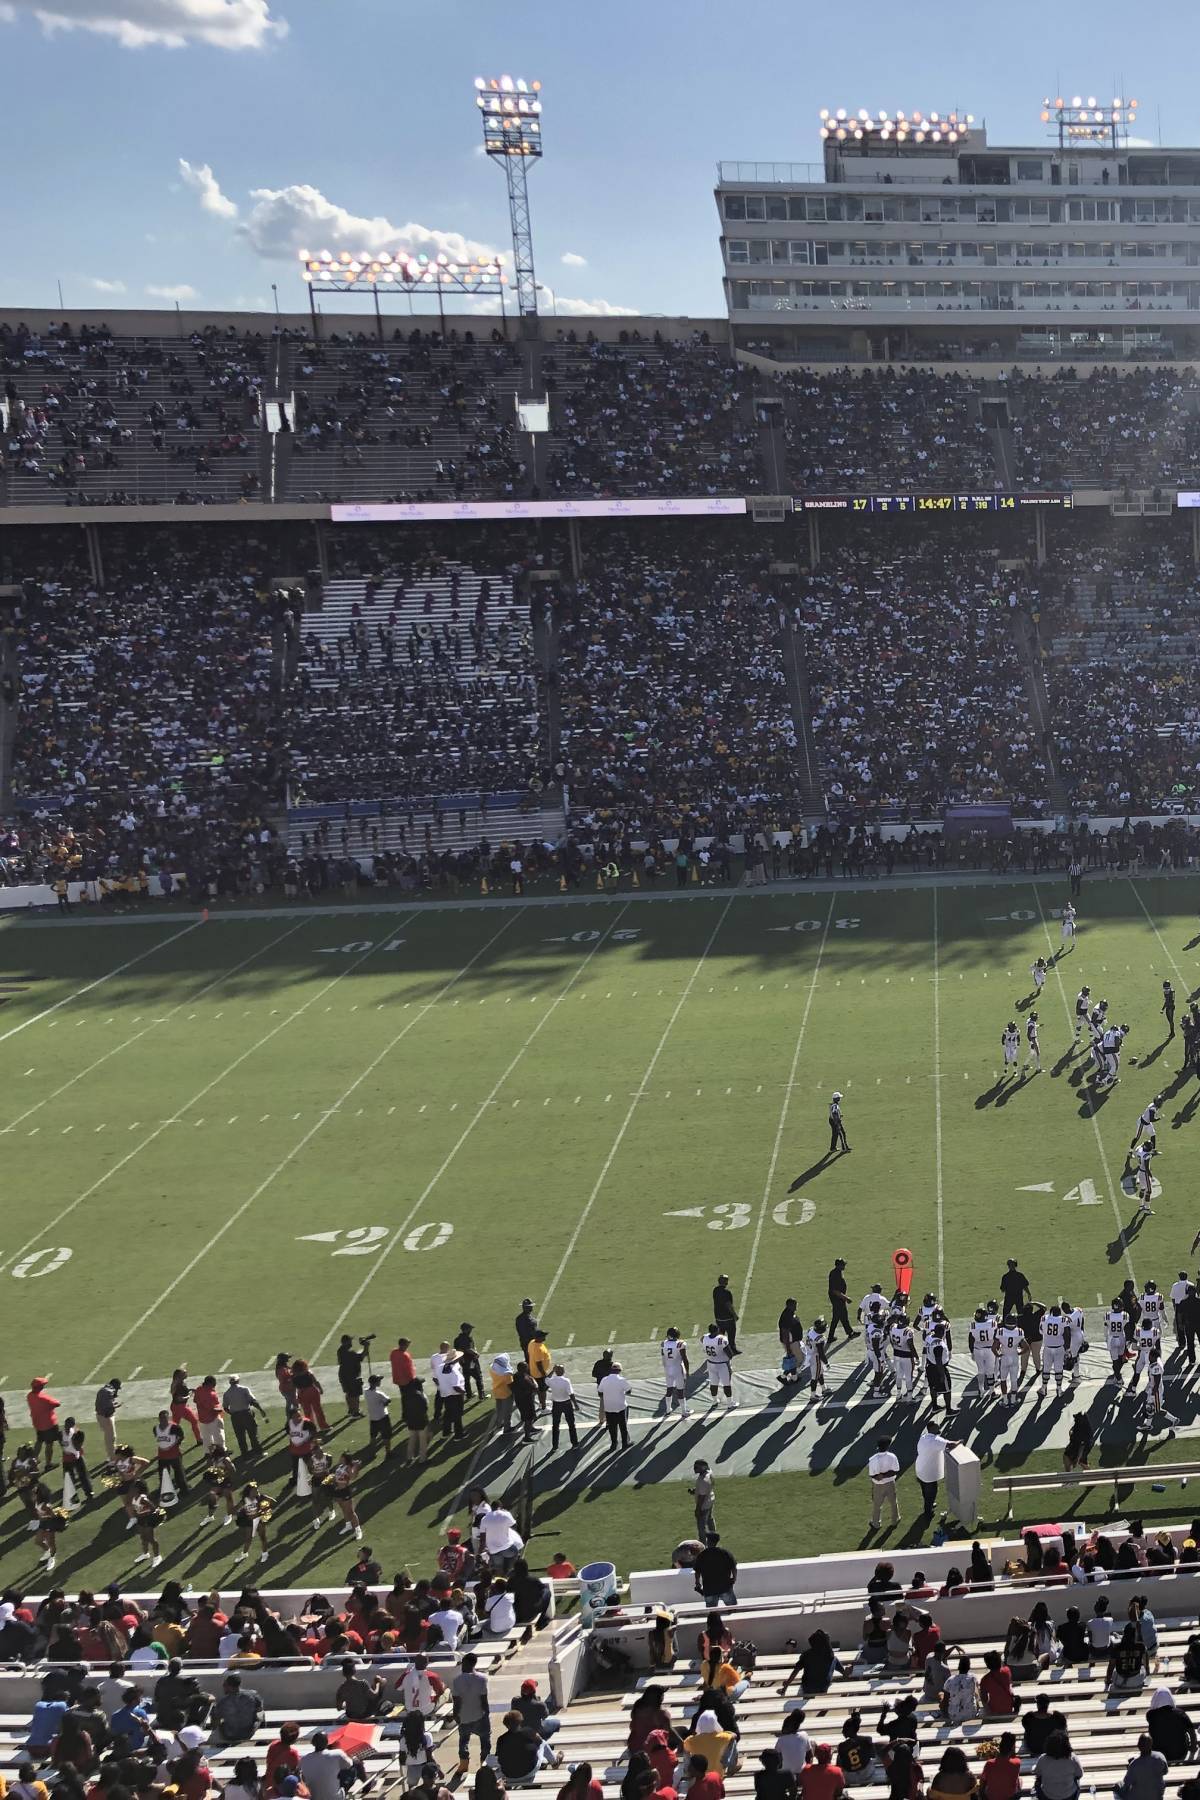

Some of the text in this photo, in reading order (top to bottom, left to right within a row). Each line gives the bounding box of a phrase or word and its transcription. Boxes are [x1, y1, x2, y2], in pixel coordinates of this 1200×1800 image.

[853, 499, 867, 510] 17
[881, 503, 888, 511] 2
[899, 502, 906, 510] 5
[919, 498, 951, 509] 14:47
[1000, 497, 1014, 508] 14
[794, 918, 860, 931] 30
[571, 928, 641, 942] 20
[341, 939, 406, 953] 10
[1063, 1177, 1162, 1205] 40
[707, 1198, 816, 1231] 30
[331, 1222, 454, 1257] 20
[1145, 1301, 1156, 1312] 88
[1046, 1323, 1058, 1336] 68
[979, 1330, 989, 1342] 61
[1007, 1337, 1013, 1348] 8
[667, 1347, 673, 1359] 2
[412, 1688, 420, 1708] 2
[848, 1748, 861, 1766] 6
